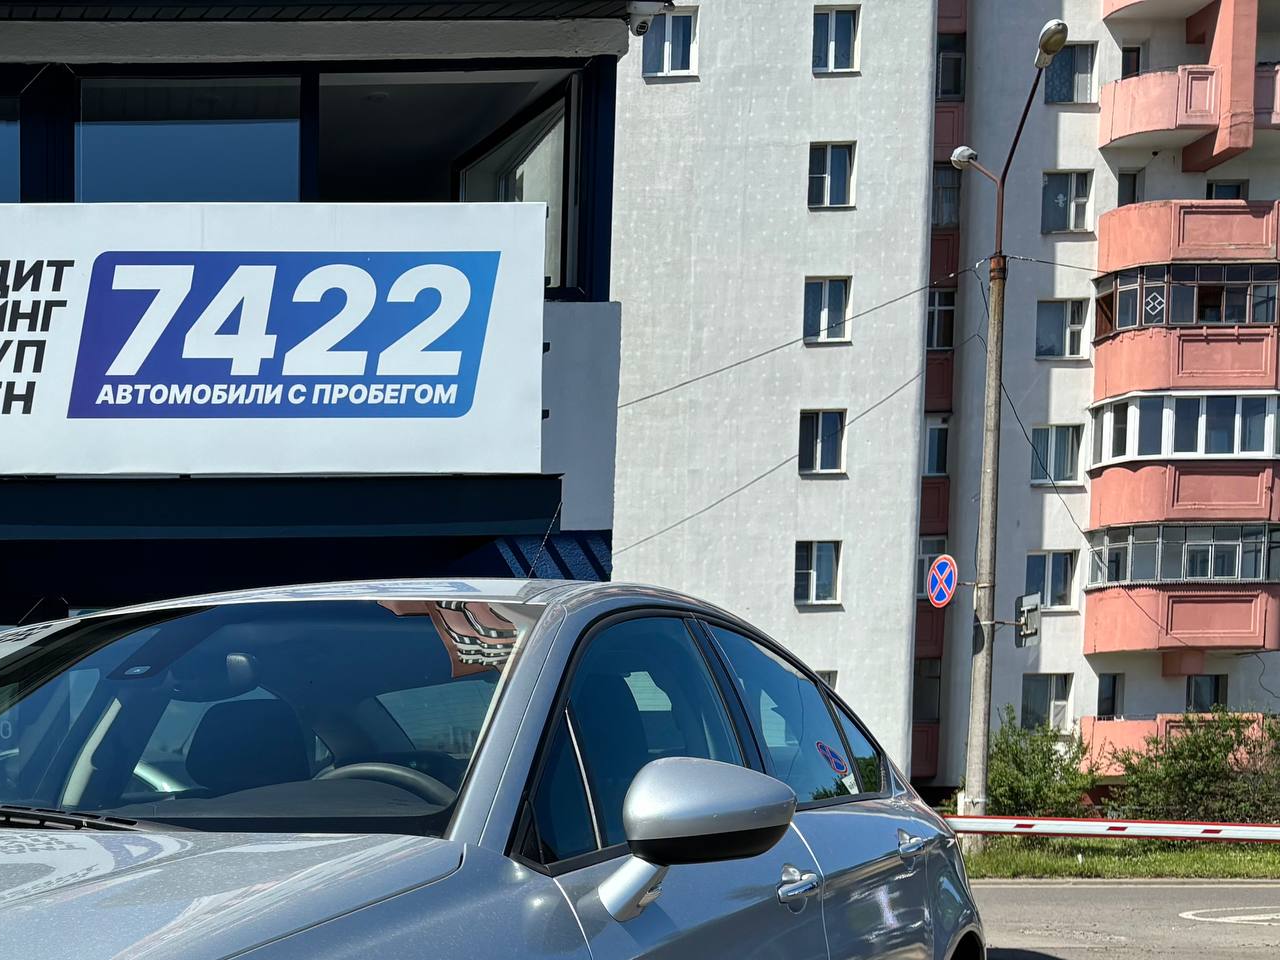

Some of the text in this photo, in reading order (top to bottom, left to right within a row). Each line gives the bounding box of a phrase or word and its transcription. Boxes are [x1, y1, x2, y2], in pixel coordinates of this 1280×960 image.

[104, 262, 473, 377] 7422
[95, 383, 459, 406] АВТОМОБИЛИ С ПРОБЕГОМ
